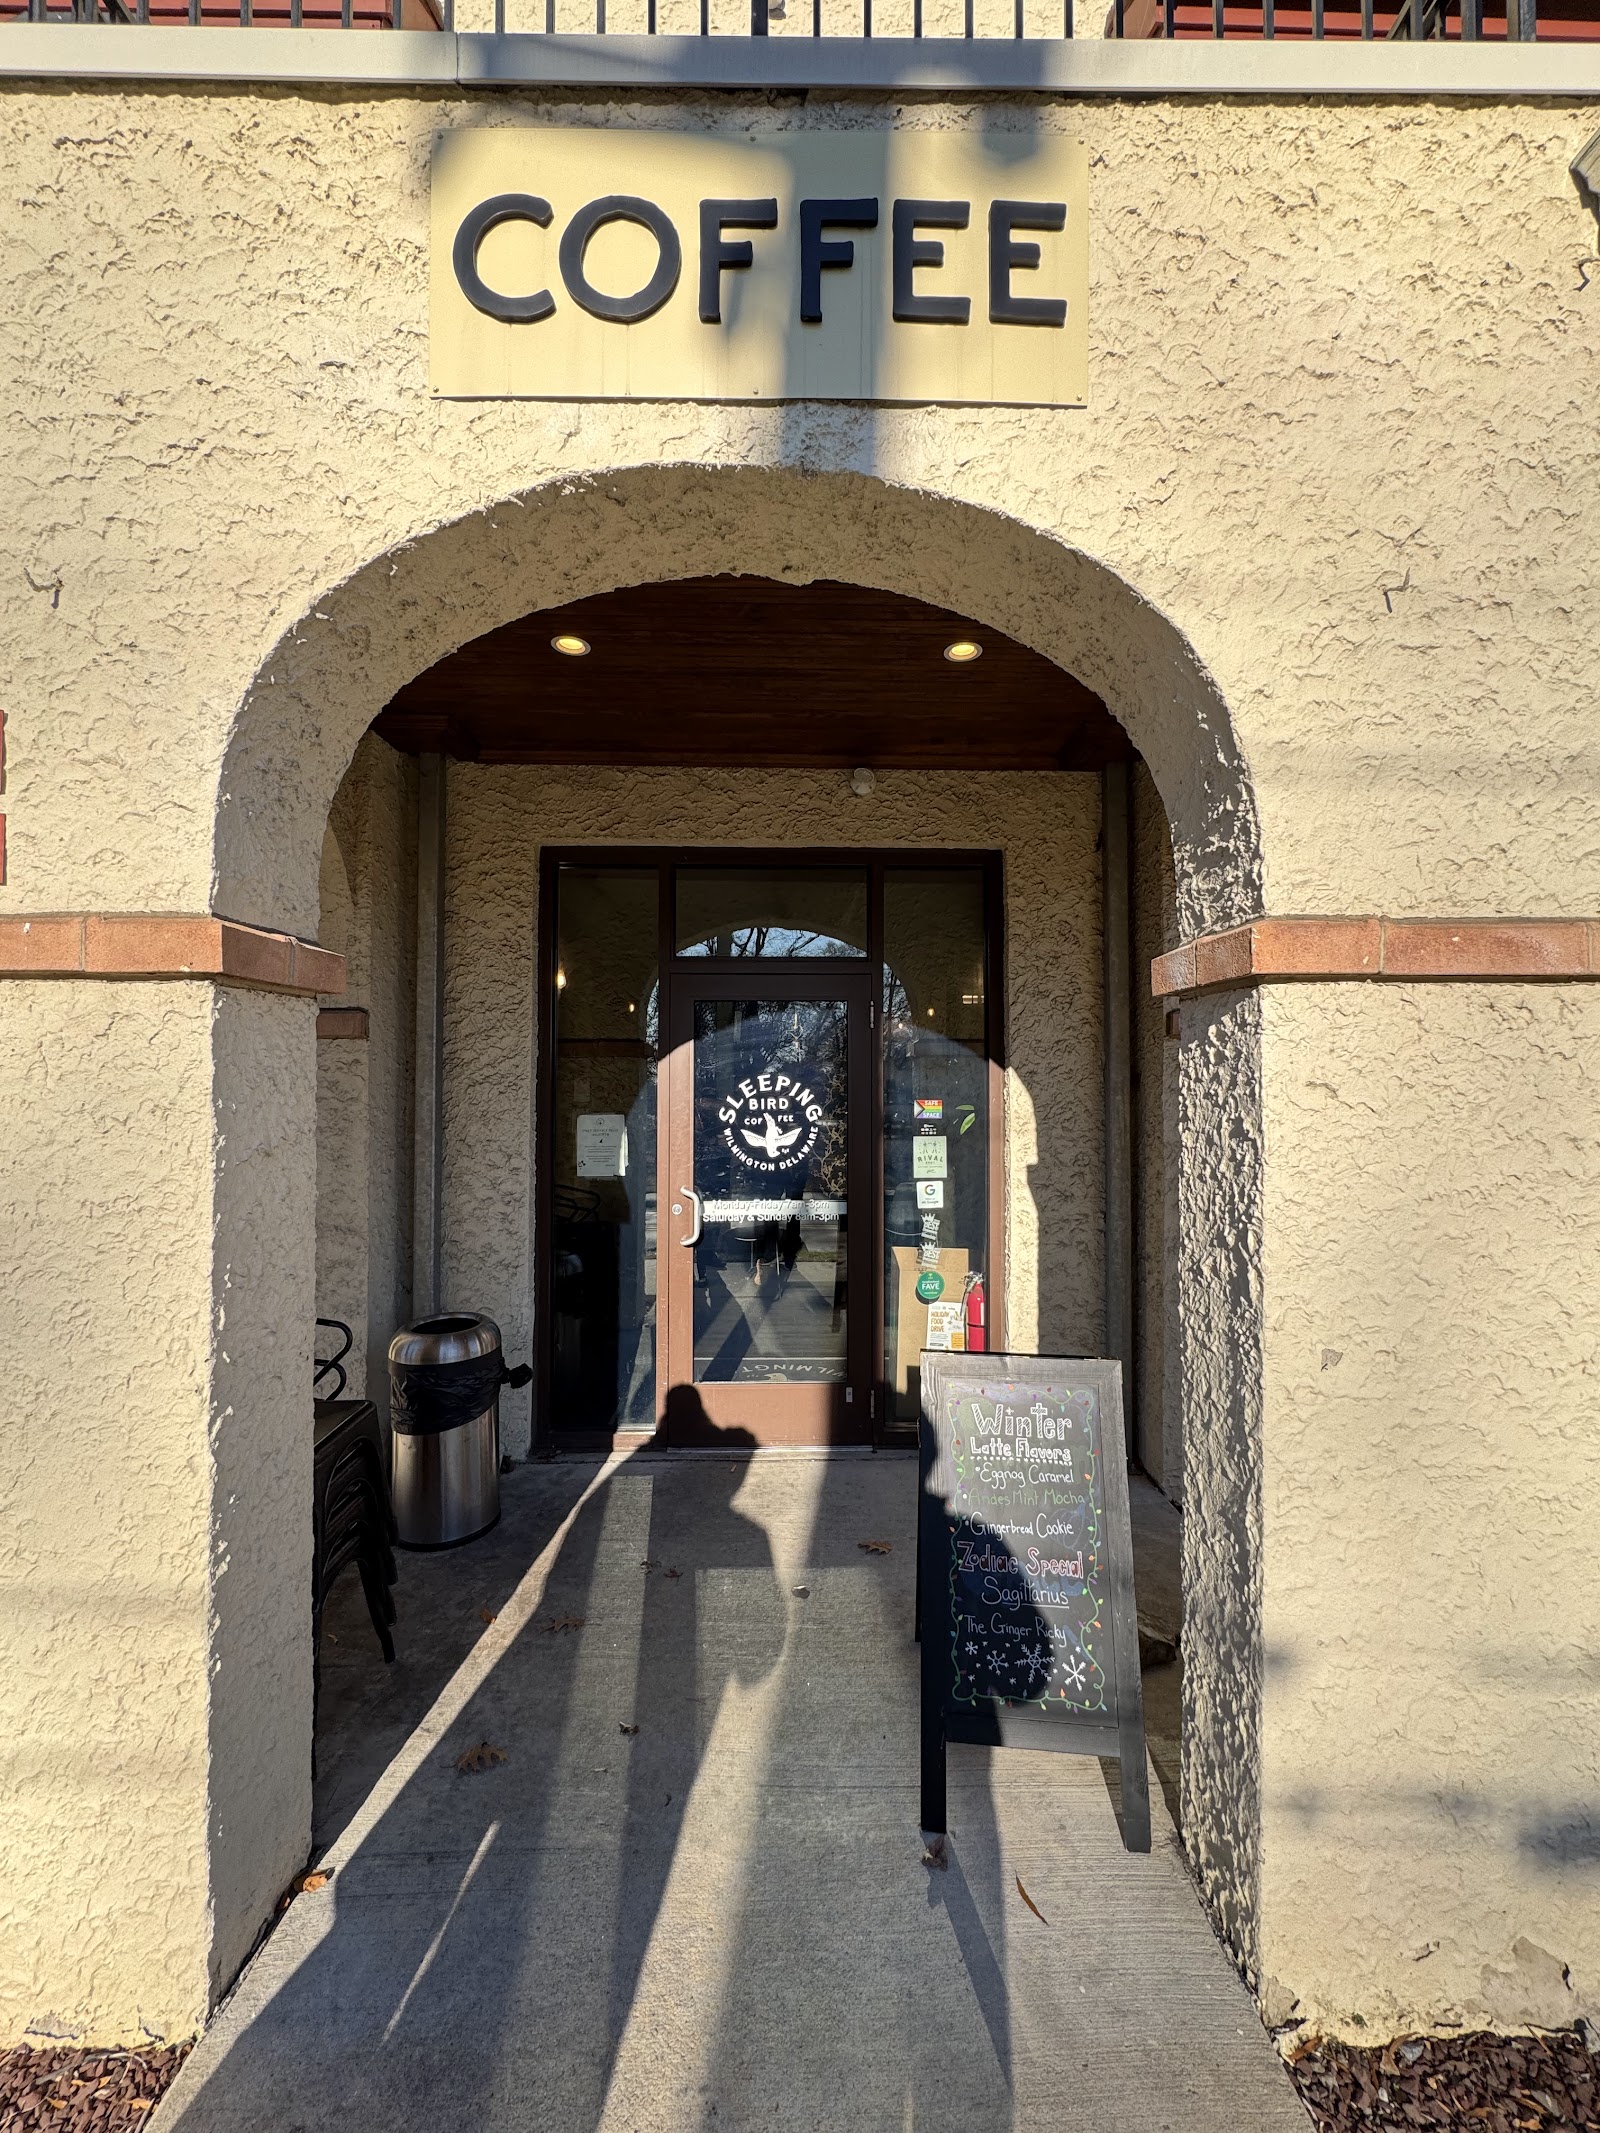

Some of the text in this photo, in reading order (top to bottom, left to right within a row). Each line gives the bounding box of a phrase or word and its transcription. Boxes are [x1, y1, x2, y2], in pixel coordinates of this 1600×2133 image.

[453, 193, 1067, 327] COFFEE
[719, 1074, 822, 1124] SLEEPING
[749, 1098, 789, 1110] BIRD
[723, 1126, 819, 1171] WILMINGTON DELAWARE
[917, 1155, 944, 1163] RIVAL
[703, 1212, 840, 1223] Saturday & Sunday 8am-3pm
[714, 1199, 783, 1211] Monday-Friday
[922, 1282, 940, 1290] FAVE
[971, 1402, 1073, 1440] Winter
[970, 1437, 1072, 1462] Latte Flavors
[980, 1462, 1074, 1490] Eggnog Caramel
[968, 1488, 1086, 1506] Andes Mint Mocha
[970, 1511, 1074, 1541] Gingerbread Cookie
[957, 1540, 1084, 1580] Zodiac Special
[981, 1576, 1069, 1611] Sagittarius
[964, 1612, 1067, 1647] The Ginger Ricky
